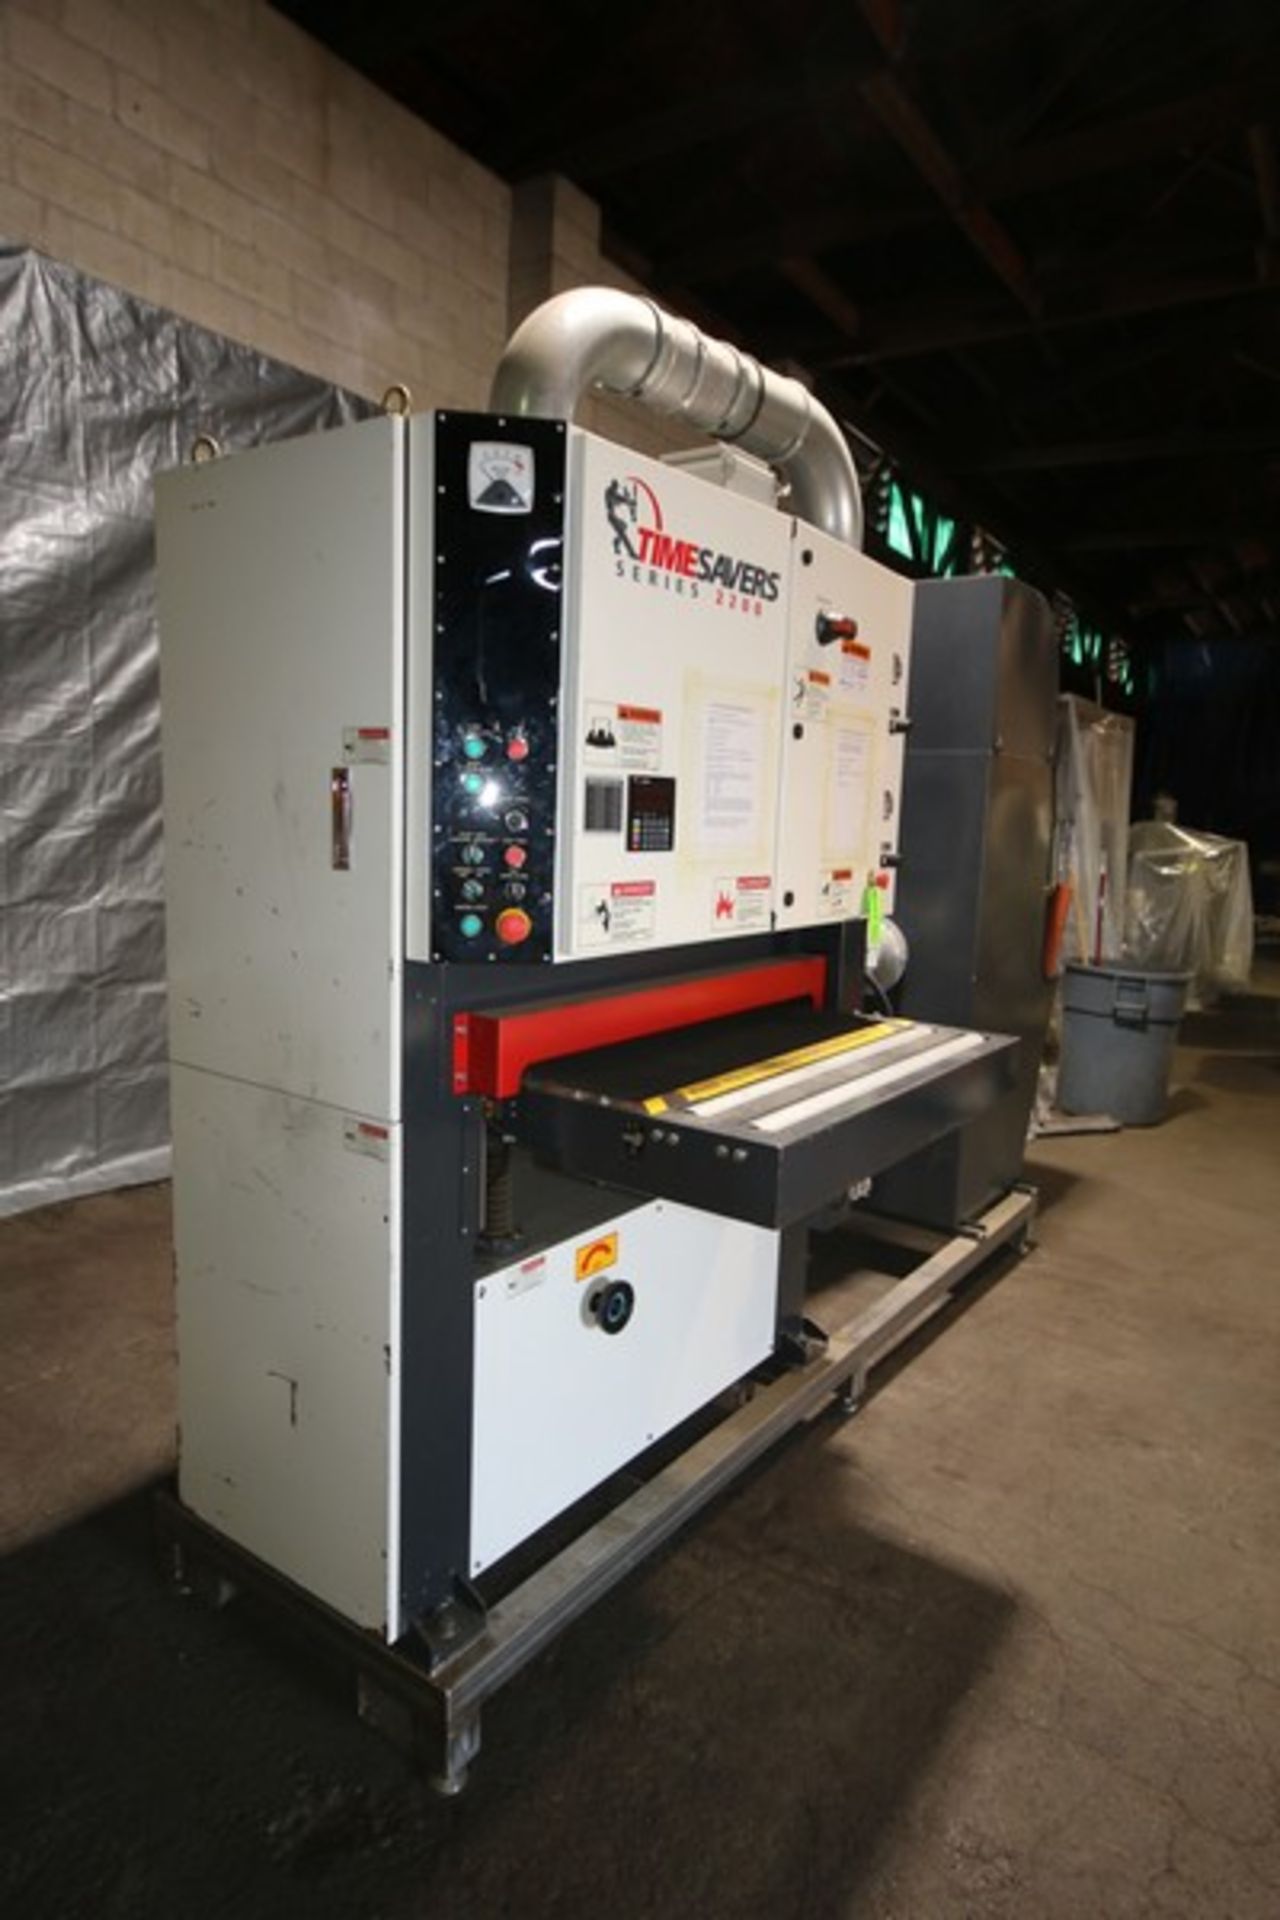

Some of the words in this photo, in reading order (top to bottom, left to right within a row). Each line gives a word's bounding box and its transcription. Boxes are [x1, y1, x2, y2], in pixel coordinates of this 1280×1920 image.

[616, 560, 699, 598] SERIES
[715, 589, 762, 616] 2200
[638, 527, 780, 602] TIMESAVERS
